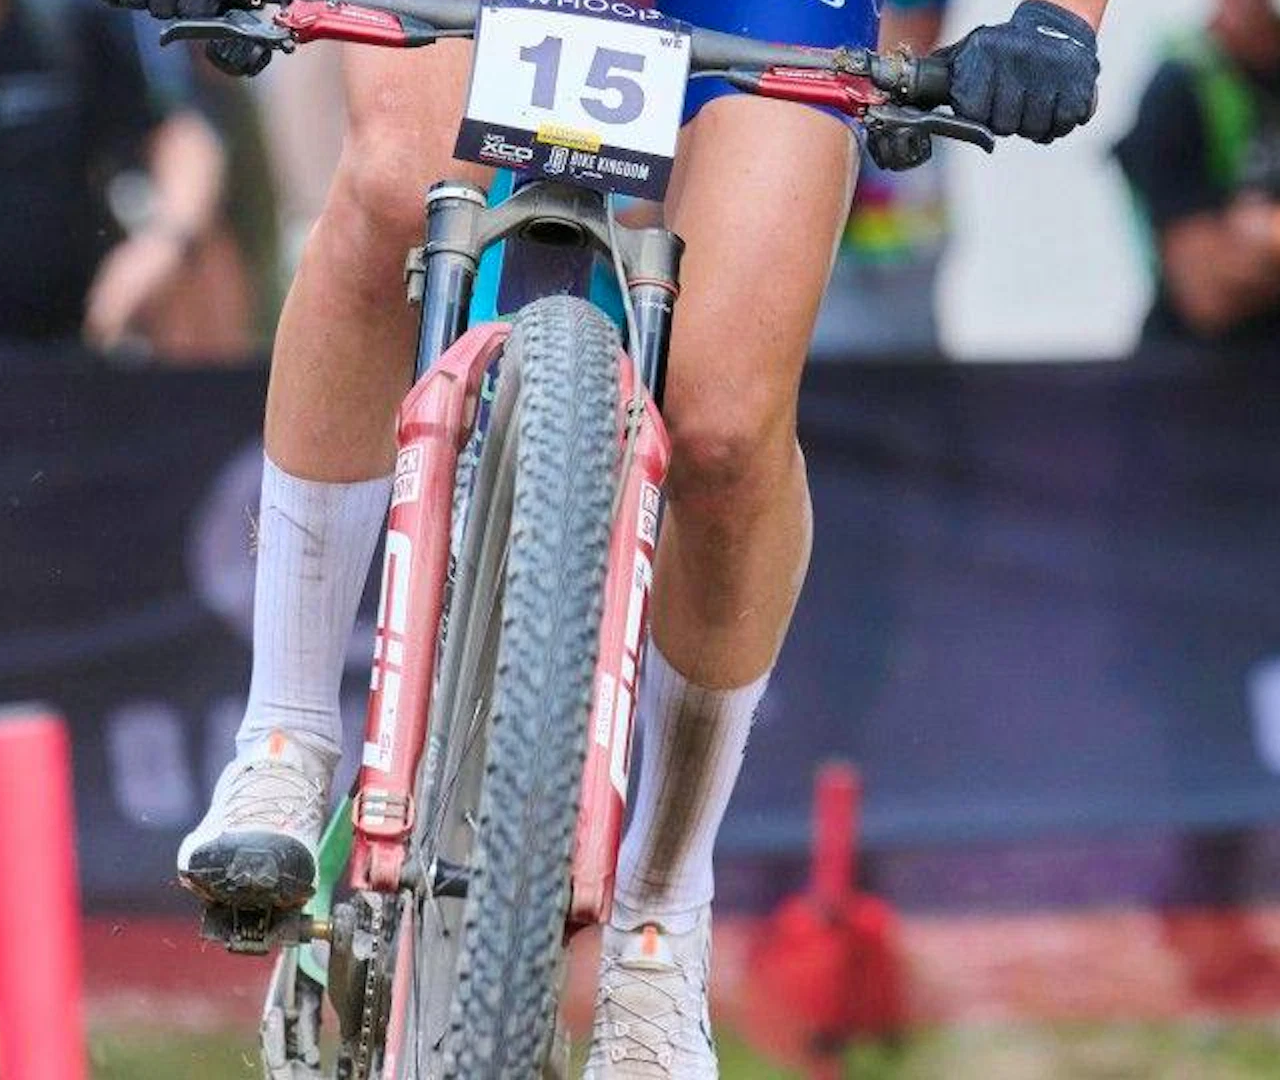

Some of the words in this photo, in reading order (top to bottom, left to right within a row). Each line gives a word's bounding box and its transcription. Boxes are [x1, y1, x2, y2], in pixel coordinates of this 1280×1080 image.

[659, 37, 683, 49] WE
[519, 35, 646, 125] 15
[480, 139, 533, 161] XCO
[597, 156, 650, 181] KINGDOM
